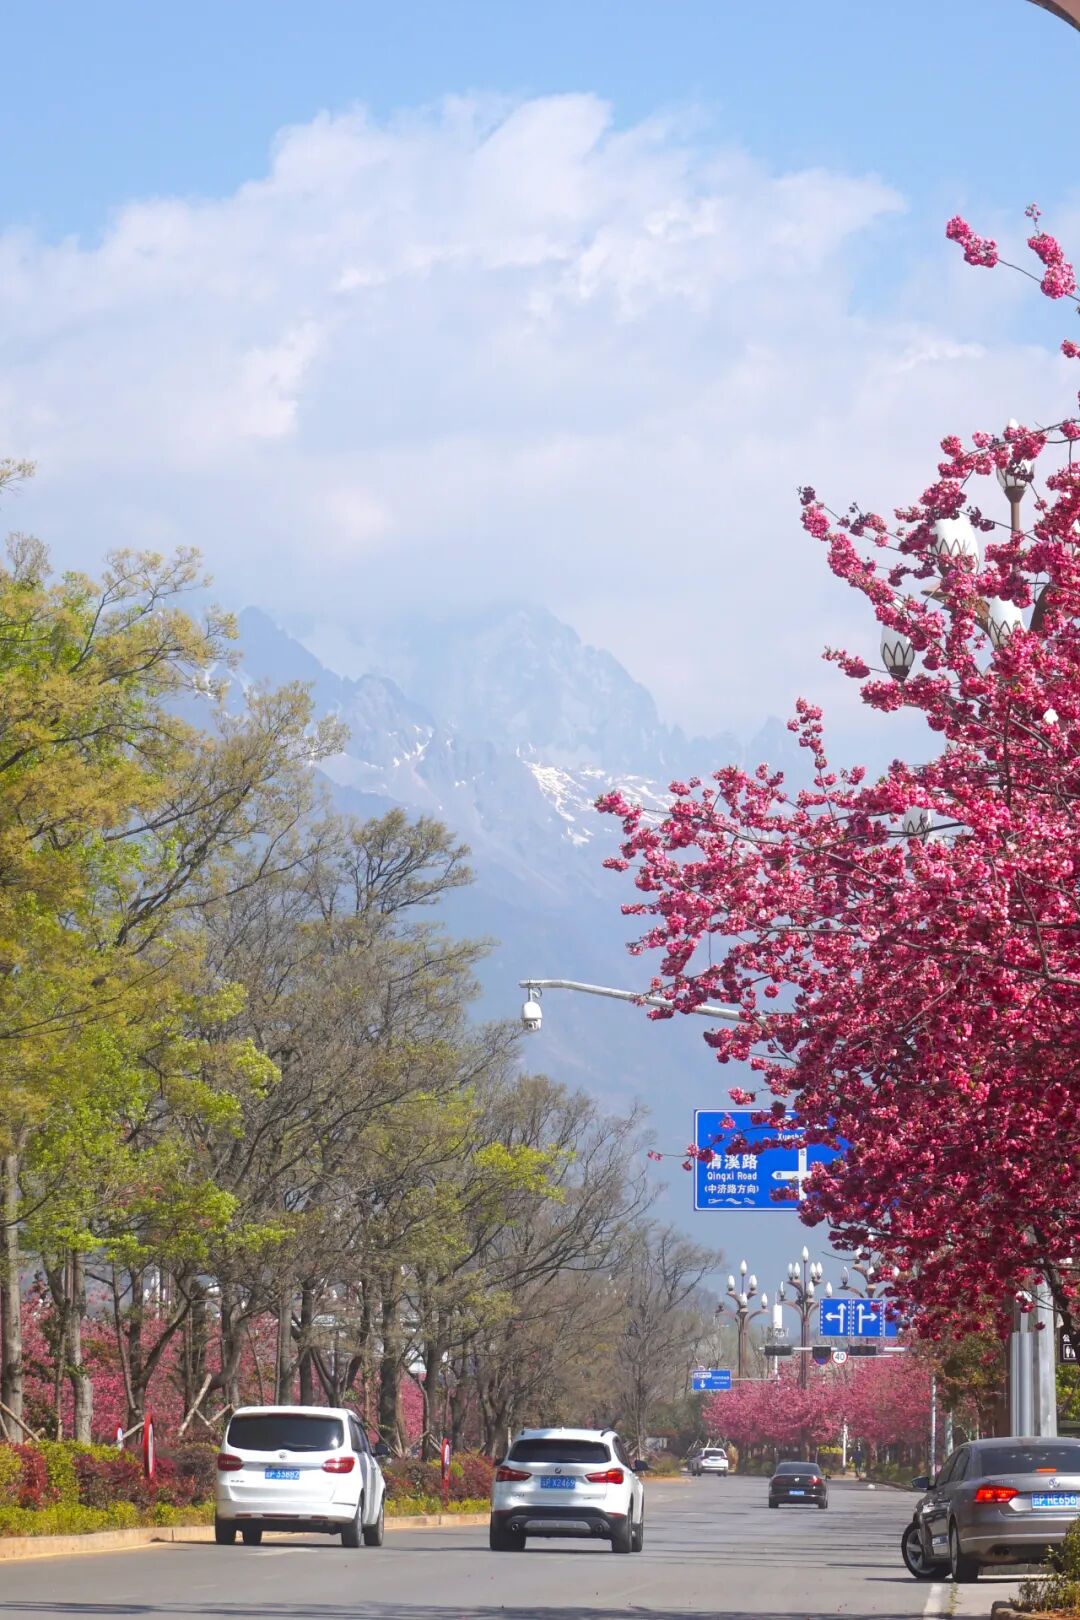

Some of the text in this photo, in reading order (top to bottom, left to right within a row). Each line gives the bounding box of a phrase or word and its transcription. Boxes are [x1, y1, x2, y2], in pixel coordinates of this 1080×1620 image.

[706, 1153, 758, 1169] 清溪路
[707, 1171, 758, 1182] Qingxi Road
[835, 1352, 845, 1361] 40
